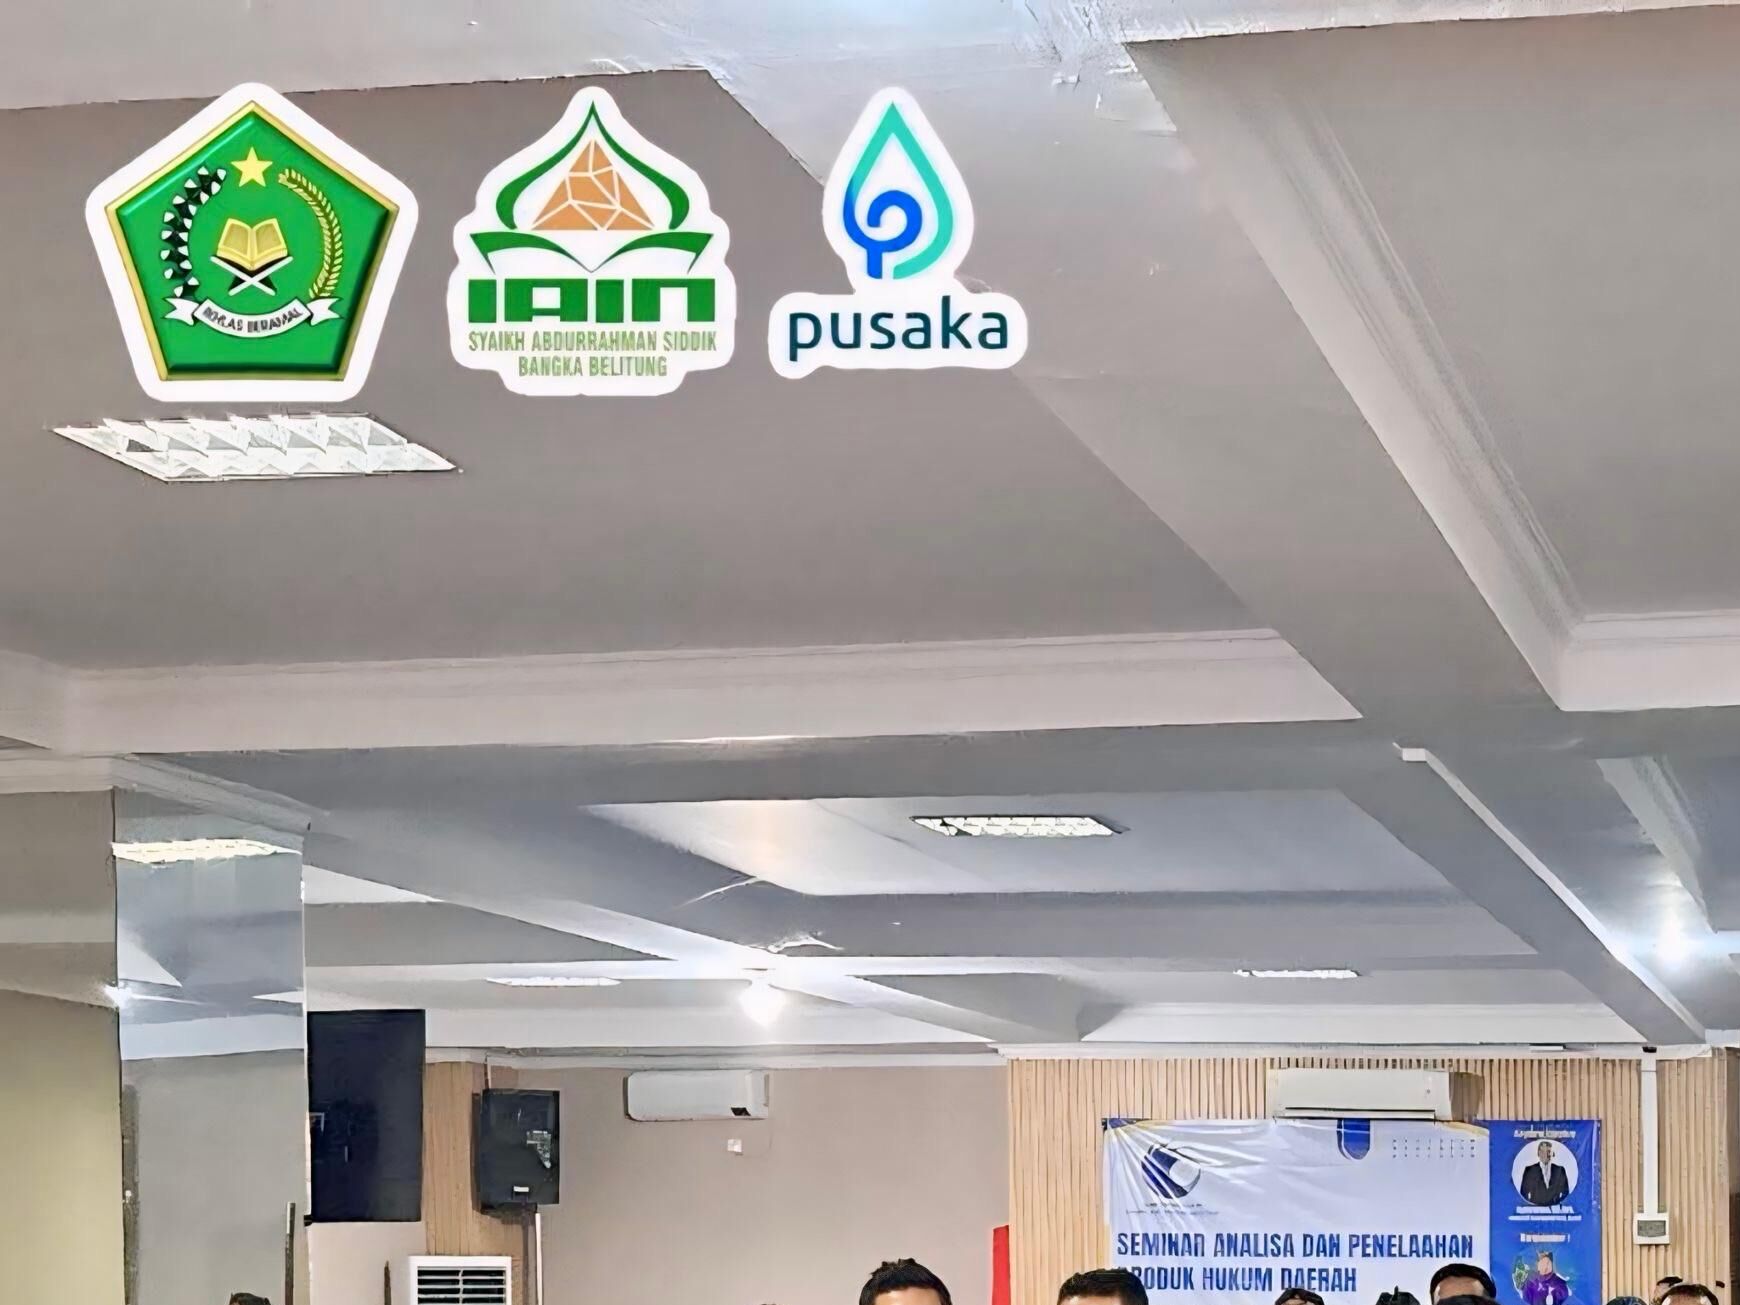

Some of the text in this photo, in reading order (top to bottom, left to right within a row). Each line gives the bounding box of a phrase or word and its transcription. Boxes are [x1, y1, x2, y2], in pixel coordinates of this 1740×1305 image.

[1117, 1232, 1473, 1259] SEMINAR ANALISA DAN PENELAAHAN
[1118, 1265, 1357, 1292] RODUK HUKUM DAERAH
